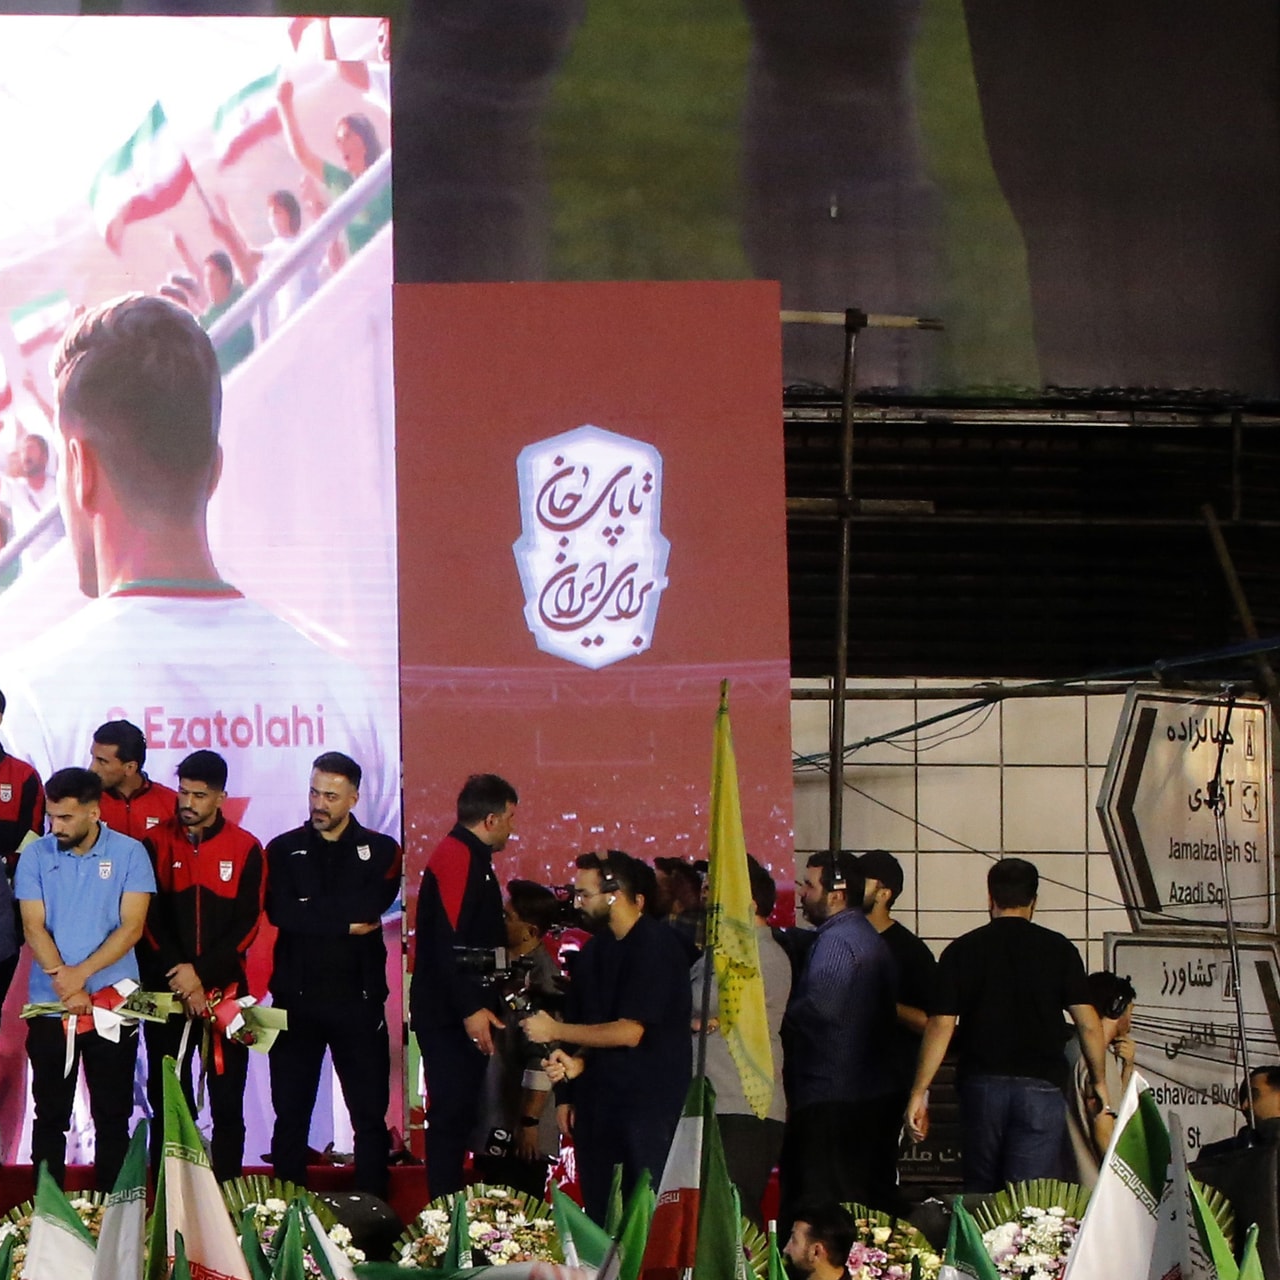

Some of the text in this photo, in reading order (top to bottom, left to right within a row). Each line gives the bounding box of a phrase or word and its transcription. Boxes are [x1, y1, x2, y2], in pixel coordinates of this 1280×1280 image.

[144, 703, 326, 750] Ezatolahi
[1244, 841, 1262, 864] St.
[1169, 881, 1204, 903] Azadi
[1160, 957, 1217, 997] کشاورز
[1149, 1082, 1208, 1106] eshavarz
